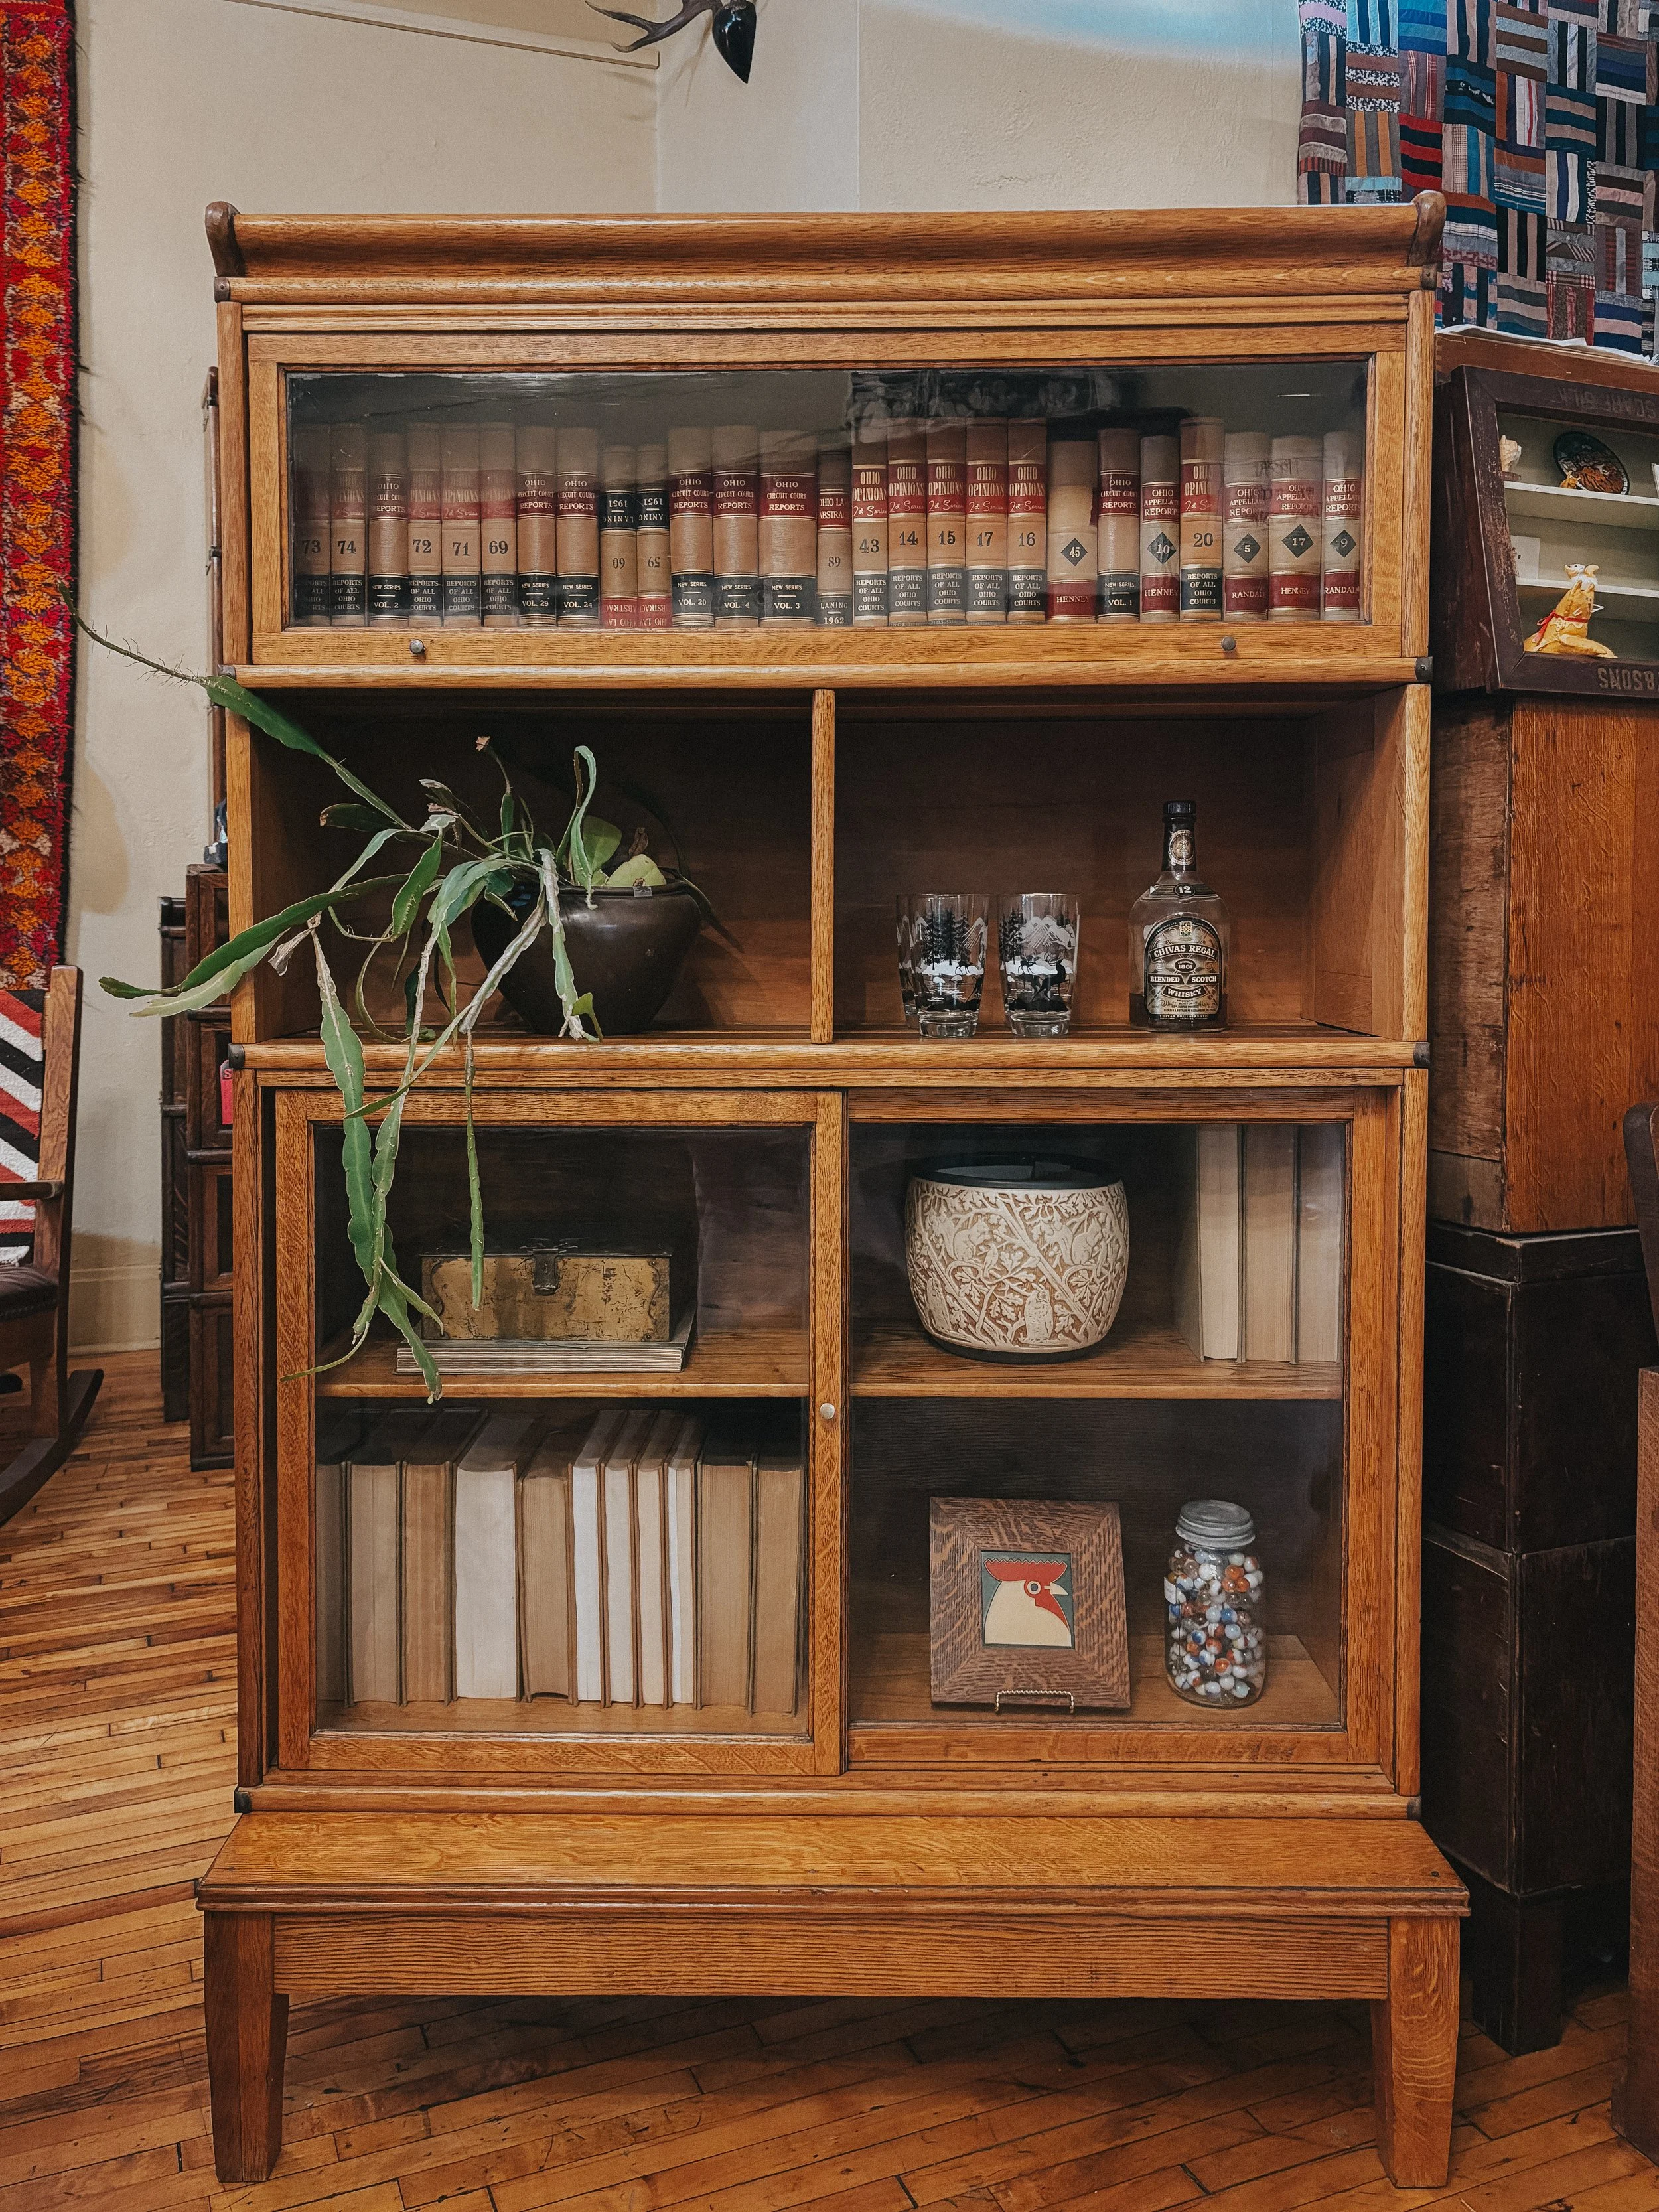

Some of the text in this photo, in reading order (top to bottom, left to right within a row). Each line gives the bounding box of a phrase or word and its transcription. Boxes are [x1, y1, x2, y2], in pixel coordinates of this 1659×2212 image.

[860, 471, 881, 485] OHIO
[897, 466, 916, 480] OHIO
[936, 465, 956, 479] OHIO
[977, 467, 997, 480] OHIO
[1017, 467, 1037, 480] OHIO
[889, 482, 924, 496] OPINIONS
[969, 483, 1005, 497] OPINIONS
[1009, 482, 1045, 497] OPINIONS
[1237, 488, 1260, 497] OHIO
[1333, 484, 1356, 493] OHIO
[853, 506, 864, 517] 2d
[889, 502, 901, 512] 2d
[929, 500, 940, 512] 2d
[969, 502, 979, 512] 2d
[1009, 501, 1021, 512] 2d
[899, 531, 918, 546] 14
[938, 531, 956, 546] 15
[977, 532, 993, 547] 17
[1019, 532, 1035, 547] 16
[1193, 533, 1213, 547] 20
[1340, 539, 1348, 548] 9
[302, 540, 321, 554] 73
[337, 540, 356, 555] 74
[412, 539, 432, 553] 72
[453, 542, 470, 556] 71
[489, 540, 508, 555] 69
[859, 539, 879, 553] 43
[1068, 546, 1081, 558] 45
[1157, 544, 1170, 555] 10
[1244, 544, 1252, 553] 5
[613, 557, 625, 569] 60
[648, 557, 661, 568] 59
[828, 556, 841, 568] 89
[1154, 944, 1216, 958] CHIVAS REGAL
[1167, 988, 1202, 997] WHISKY
